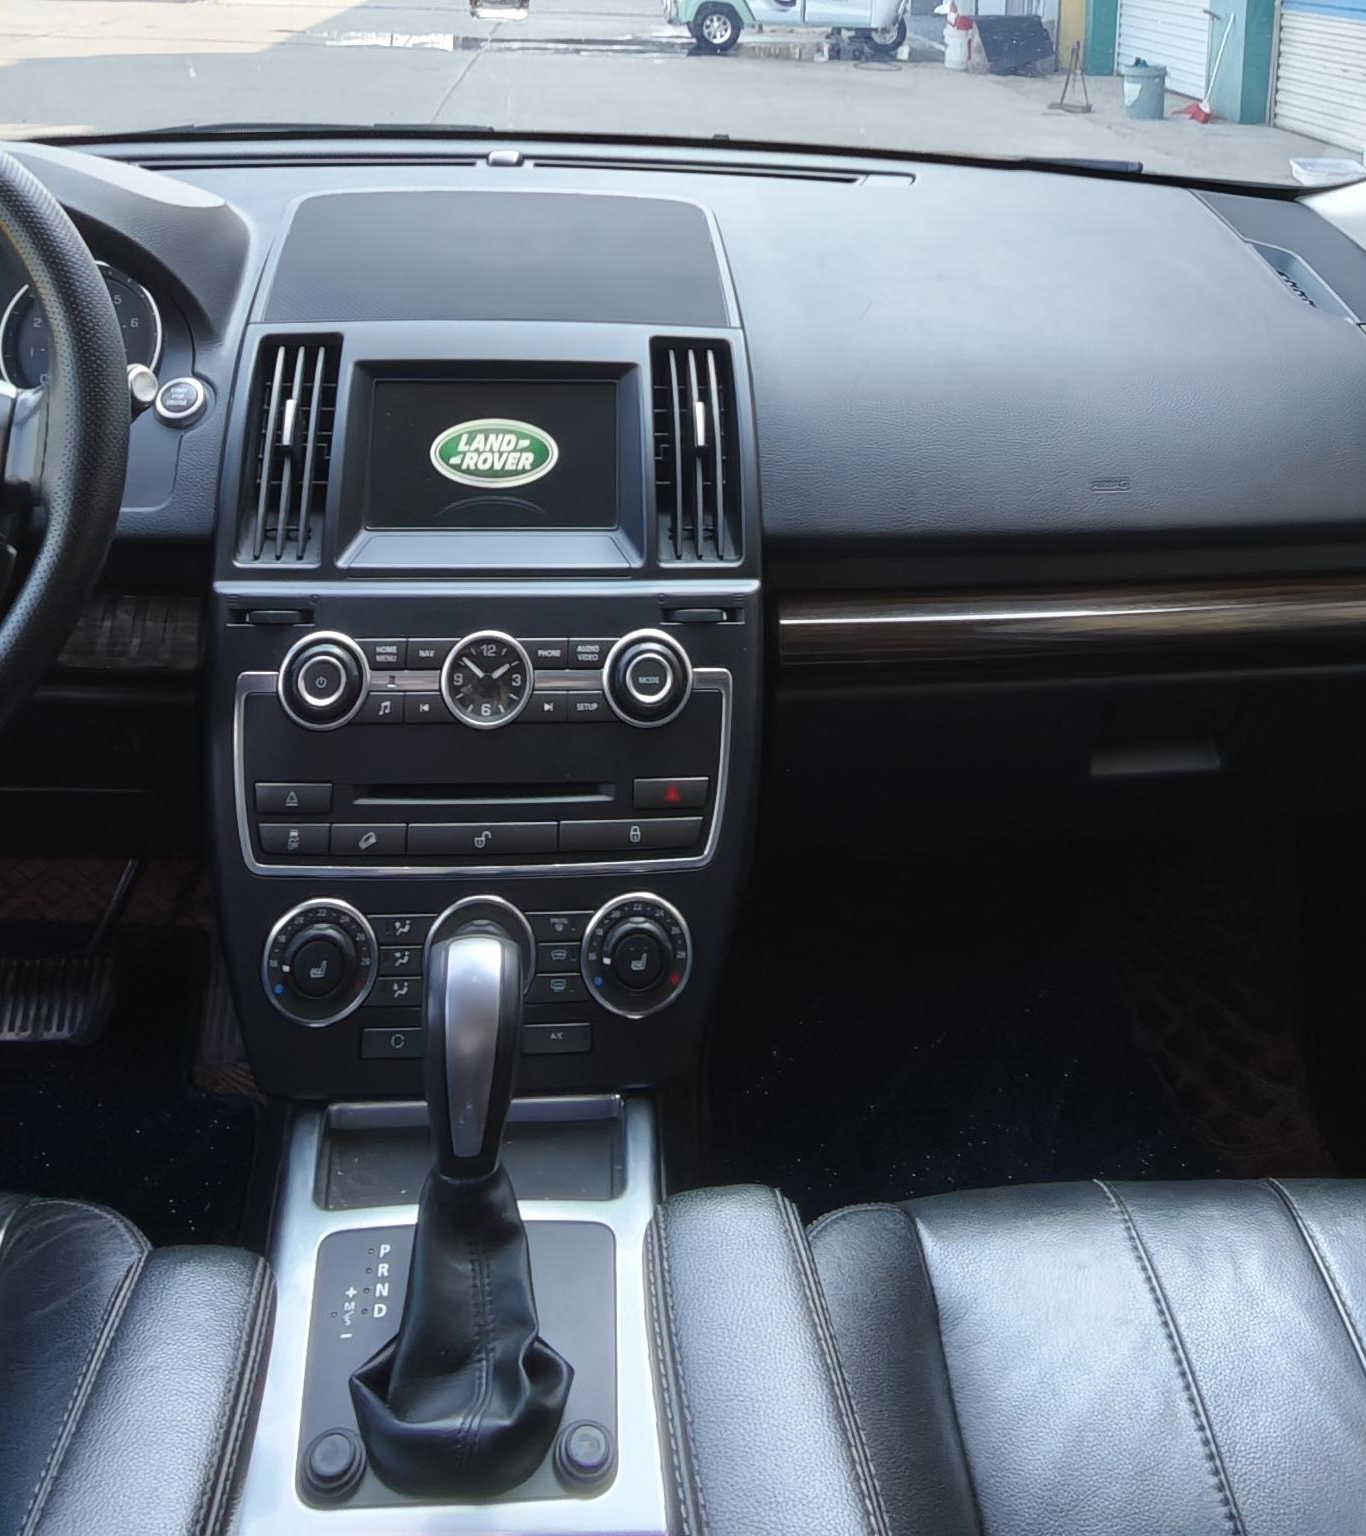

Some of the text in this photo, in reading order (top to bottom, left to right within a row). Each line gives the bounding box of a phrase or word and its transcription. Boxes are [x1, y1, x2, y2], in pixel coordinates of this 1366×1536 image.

[113, 295, 122, 305] 5
[33, 318, 42, 328] 2
[130, 318, 139, 328] 6
[457, 433, 517, 451] LAND
[461, 452, 534, 470] ROVER
[480, 645, 496, 656] 12
[453, 674, 463, 685] 9
[511, 675, 521, 686] 3
[481, 704, 491, 716] 6
[576, 703, 598, 711] SETUP
[380, 1244, 391, 1257] P
[377, 1263, 389, 1277] R
[375, 1283, 389, 1297] N
[373, 1303, 387, 1318] D
